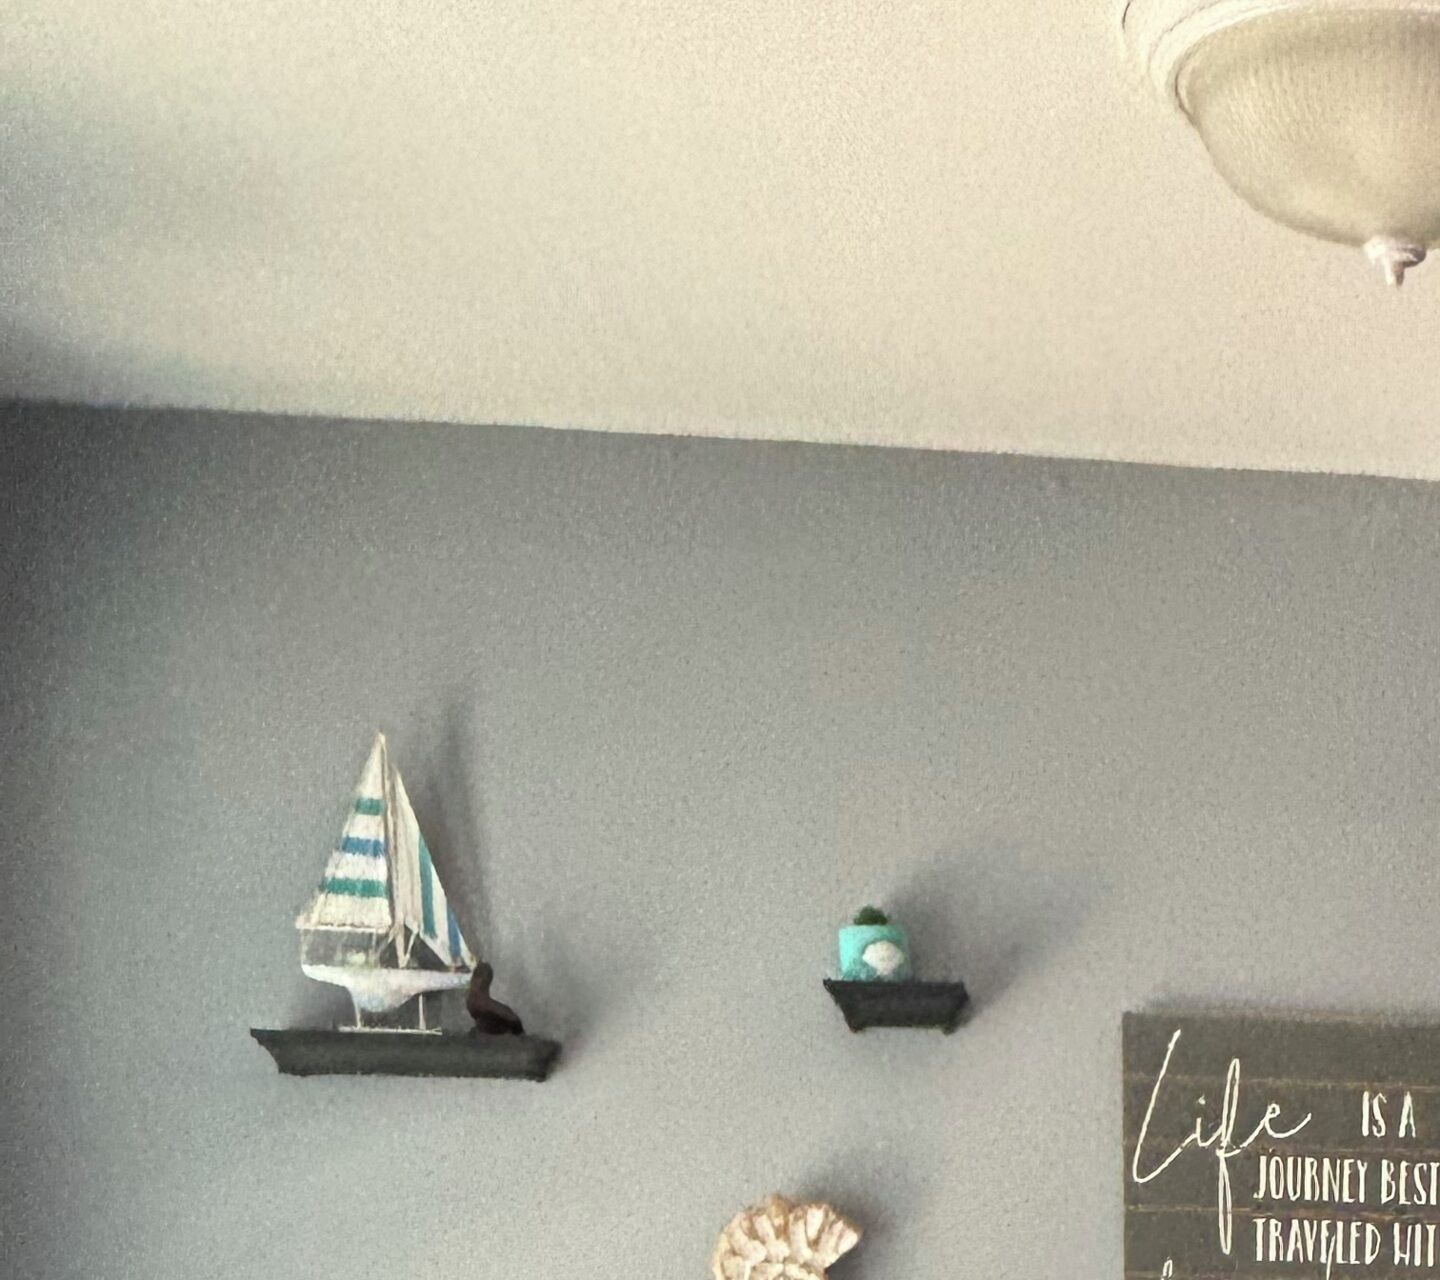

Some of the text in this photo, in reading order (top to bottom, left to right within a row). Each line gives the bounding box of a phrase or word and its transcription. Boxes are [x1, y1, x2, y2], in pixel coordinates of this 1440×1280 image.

[1133, 1030, 1416, 1254] Life IS A
[1253, 1156, 1440, 1206] JOURNEY BEST
[1254, 1218, 1381, 1265] TRAVELED
